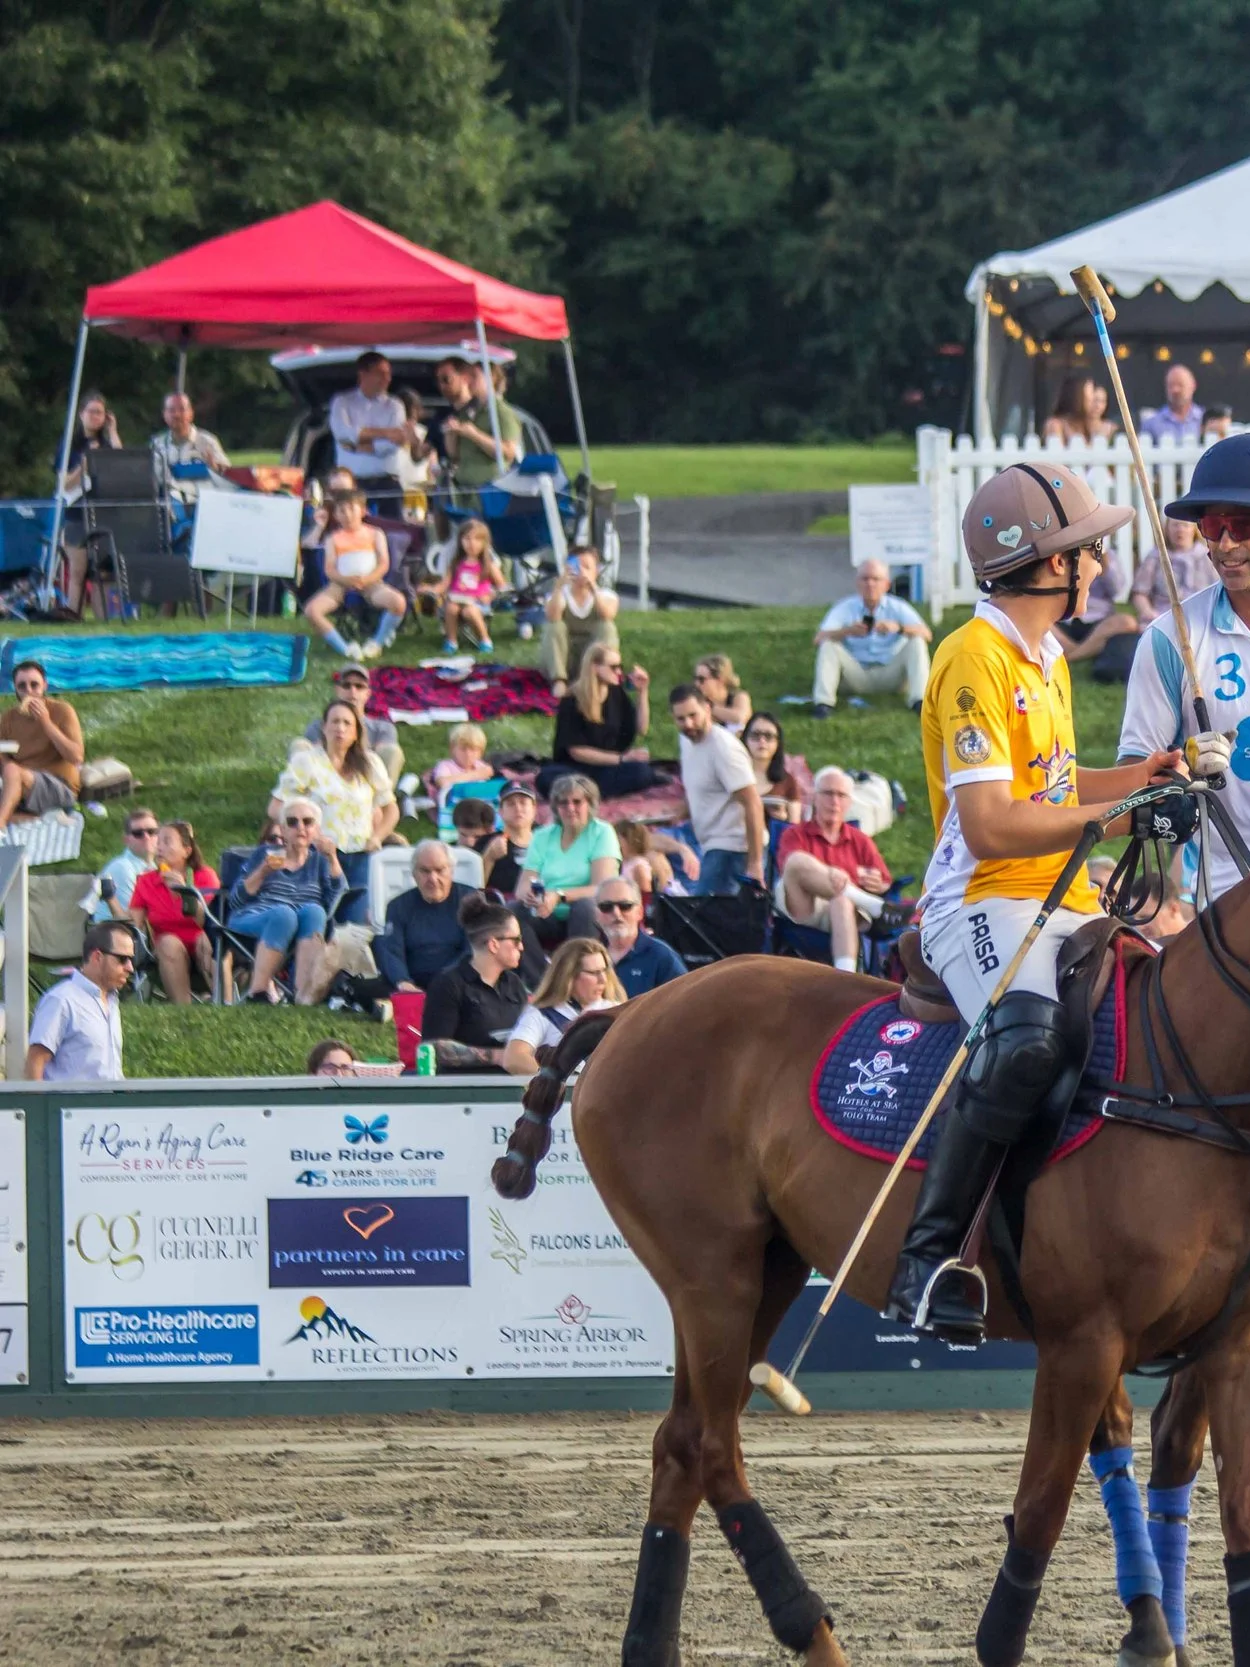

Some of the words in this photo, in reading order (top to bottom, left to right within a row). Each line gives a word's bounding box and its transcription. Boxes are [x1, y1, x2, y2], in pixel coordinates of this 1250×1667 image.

[1214, 652, 1246, 701] 3
[837, 1096, 869, 1106] HOTELS
[883, 1101, 898, 1109] SEA
[843, 1111, 863, 1119] POLO
[866, 1113, 887, 1121] TEAM
[80, 1123, 96, 1156] A
[157, 1123, 200, 1161] Aging
[208, 1123, 247, 1150] Care
[290, 1149, 332, 1162] Blue
[338, 1149, 394, 1163] Ridge
[400, 1148, 445, 1160] Care
[122, 1159, 206, 1170] SERVICES
[186, 1173, 207, 1181] CARE
[224, 1172, 247, 1180] HOME
[332, 1170, 373, 1178] YEARS
[332, 1178, 380, 1187] CARING
[384, 1178, 408, 1186] FOR
[412, 1178, 437, 1186] LIFE
[160, 1215, 258, 1236] CUCINELLI
[531, 1234, 591, 1250] FALCONS
[238, 1239, 259, 1260] PC
[274, 1248, 378, 1268] partners
[384, 1245, 406, 1262] in
[412, 1247, 466, 1262] care
[111, 1310, 256, 1330] Pro-Healthcare
[111, 1331, 173, 1344] SERVICING
[176, 1331, 198, 1344] LLC
[500, 1326, 572, 1343] SPRING
[577, 1326, 648, 1343] ARBOR
[312, 1346, 458, 1364] REFLECTIONS
[515, 1345, 570, 1353] SENIOR
[576, 1345, 629, 1353] LIVING
[107, 1352, 114, 1363] A
[116, 1352, 144, 1363] Home
[146, 1351, 196, 1363] Healthcare
[198, 1351, 233, 1364] Agency
[486, 1361, 520, 1370] Leading
[523, 1360, 541, 1368] with
[572, 1360, 608, 1368] Because
